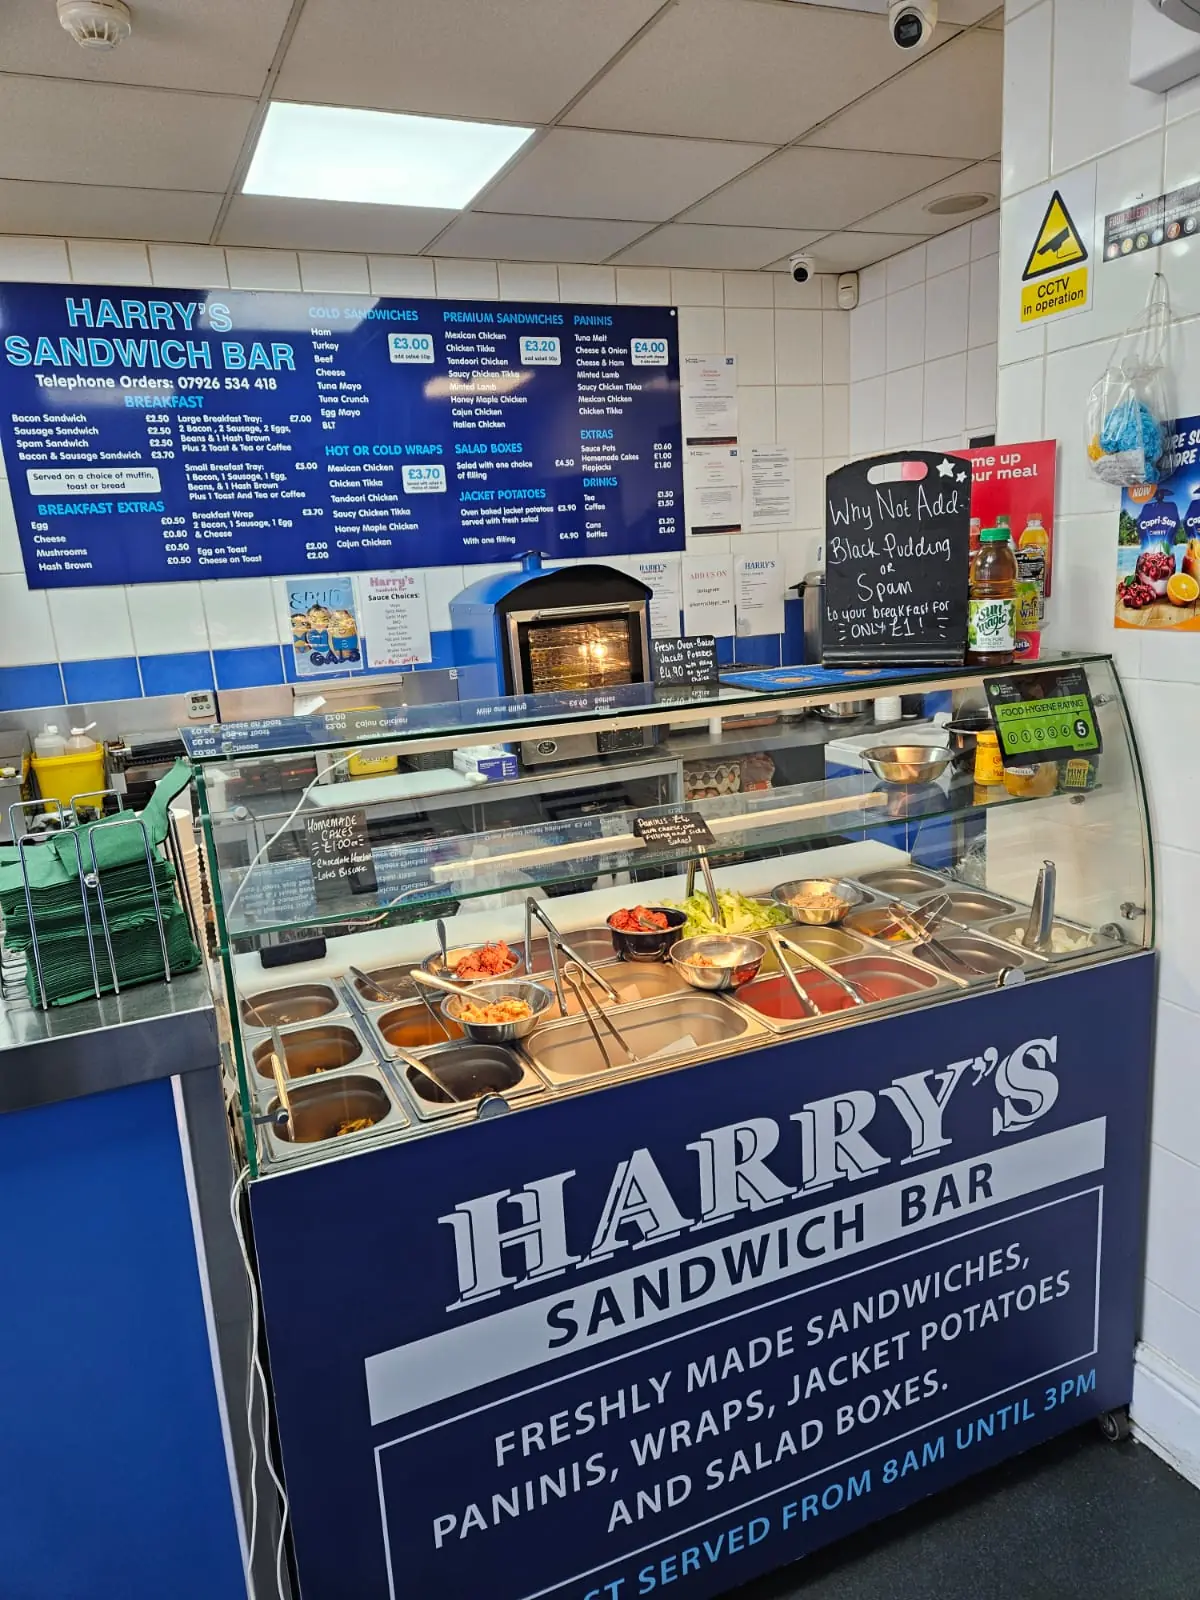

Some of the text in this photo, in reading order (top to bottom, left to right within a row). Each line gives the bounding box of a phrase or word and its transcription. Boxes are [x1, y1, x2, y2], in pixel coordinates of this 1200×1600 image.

[1037, 277, 1070, 299] CCTV
[1023, 288, 1085, 316] in operation
[66, 297, 233, 333] HARRY'S
[308, 306, 419, 321] COLD SANDWICHES
[443, 311, 564, 325] PREMIUM SANDWICHES
[573, 315, 613, 326] PANINIS
[311, 327, 332, 337] Ham
[445, 331, 507, 340] Mexican Chicken
[312, 341, 339, 352] Turkey
[393, 337, 429, 350] £3.00
[525, 340, 556, 352] £3.20
[635, 342, 665, 353] £4.00
[4, 335, 297, 371] SANDWICH BAR
[314, 354, 334, 364] Beef
[446, 357, 509, 365] Tandoori Chicken
[315, 368, 346, 377] Cheese
[34, 373, 278, 391] Telephone Orders: 07926 534 418
[316, 381, 362, 392] Tuna Mayo
[123, 394, 204, 409] BREAKFAST
[318, 394, 369, 403] Tuna Crunch
[12, 413, 170, 424] Bacon Sandwich £2.50
[320, 408, 361, 418] Egg Mayo
[14, 426, 171, 437] Sausage Sandwich £2.50
[322, 421, 336, 430] BLT
[580, 429, 614, 440] EXTRAS
[16, 438, 173, 450] Spam Sandwich £2.50
[324, 444, 443, 457] HOT OR COLD WRAPS
[454, 443, 523, 454] SALAD BOXES
[19, 450, 175, 462] Bacon & Sausage Sandwich £3.70
[1000, 453, 1021, 466] up
[33, 472, 63, 481] Served
[65, 473, 76, 481] on
[86, 471, 112, 481] choice
[114, 471, 124, 480] of
[125, 471, 155, 481] muffin,
[408, 468, 441, 480] £3.70
[997, 464, 1038, 480] meal
[66, 482, 88, 491] toast
[101, 481, 126, 491] bread
[583, 477, 618, 488] DRINKS
[459, 489, 546, 502] JACKET POTATOES
[1132, 485, 1152, 498] NOW
[37, 500, 166, 516] BREAKFAST EXTRAS
[829, 497, 873, 530] Why
[875, 488, 912, 521] Not
[31, 516, 186, 532] Egg £0.50
[33, 529, 188, 544] Cheese £0.80
[36, 542, 190, 557] Mushrooms £0.50
[828, 532, 952, 564] Black Pudding
[38, 555, 192, 572] Hash Brown £0.50
[369, 575, 415, 588] Harry's
[857, 573, 913, 602] Spam
[368, 594, 389, 602] Sauce
[827, 606, 840, 622] to
[841, 608, 867, 623] your
[851, 622, 886, 639] ONLY
[659, 666, 684, 679] £4.90
[1001, 699, 1085, 717] FOOD HYGIENE RATING
[1076, 721, 1086, 738] 5
[321, 826, 354, 841] CAKES
[438, 1035, 1061, 1313] HARRY'S
[547, 1162, 994, 1349] SANDWICH BAR
[494, 1242, 1030, 1468] FRESHLY MADE SANDWICHES,
[432, 1269, 1072, 1550] PANINIS, WRAPS, JACKET POTATOES
[607, 1368, 949, 1533] AND SALAD BOXES.
[638, 1514, 771, 1594] SERVED
[781, 1472, 873, 1530] FROM
[881, 1437, 946, 1487] 8AM
[955, 1395, 1037, 1451] UNTIL
[1044, 1368, 1098, 1411] 3PM
